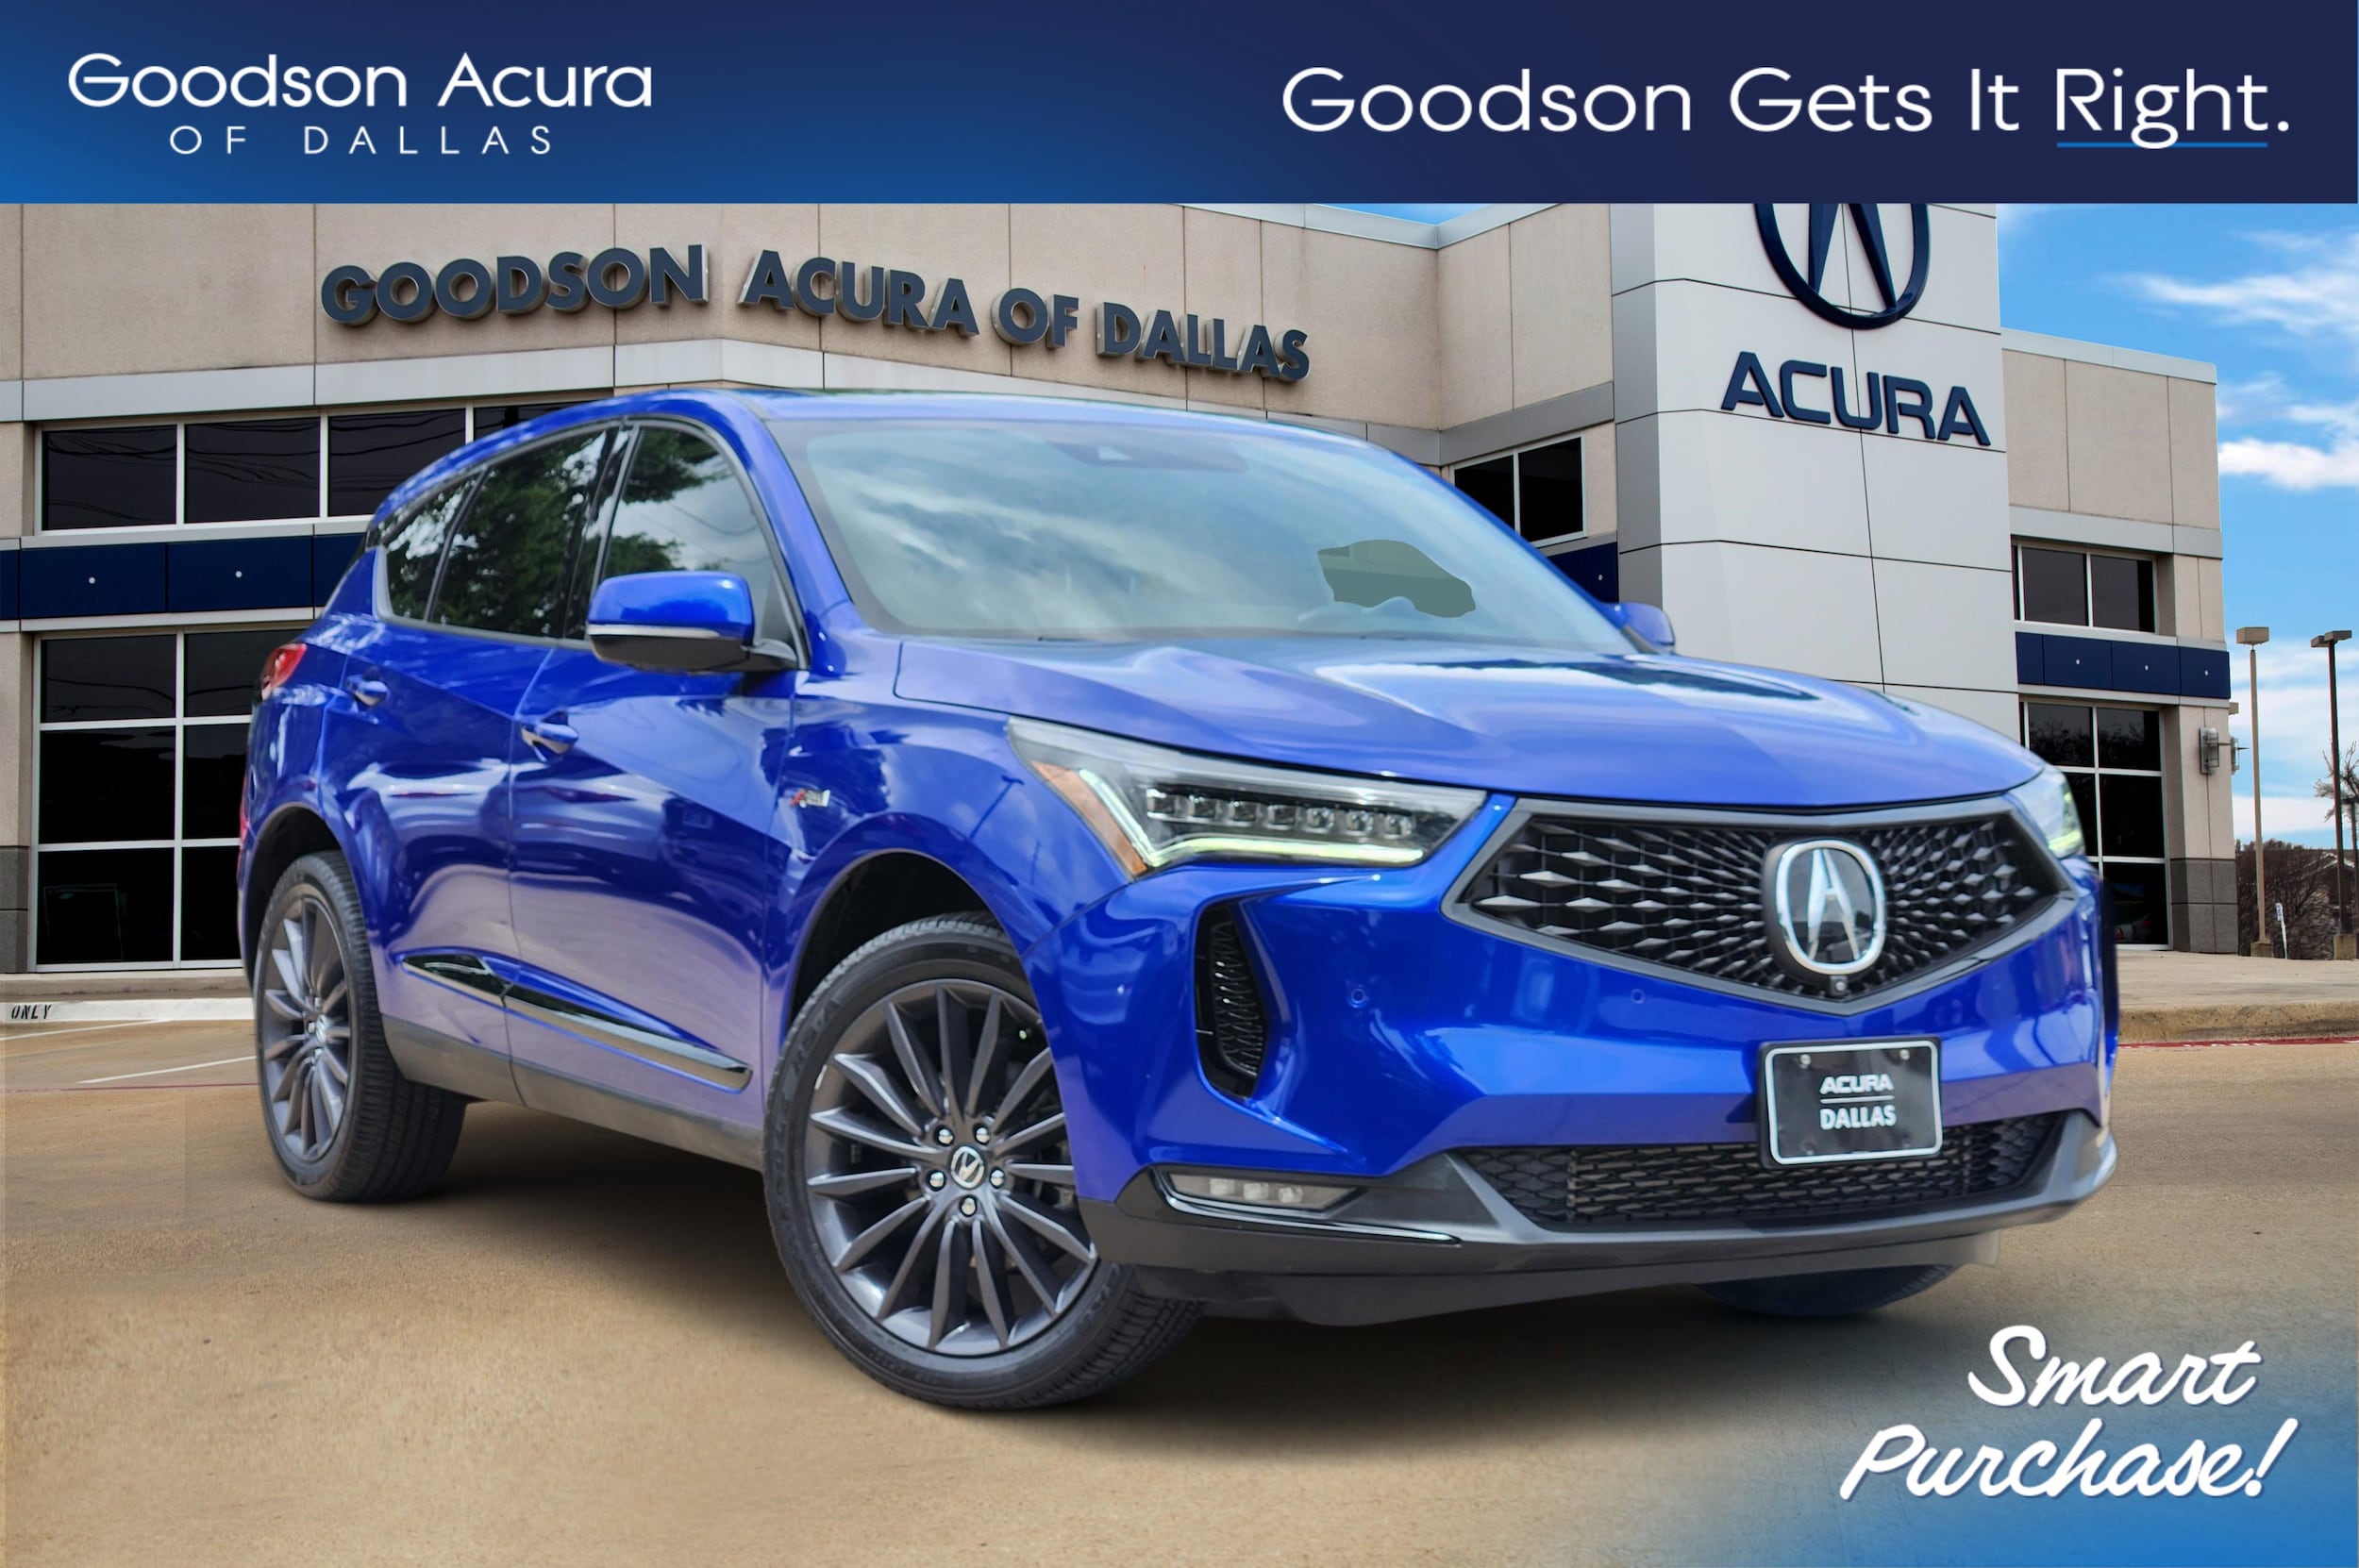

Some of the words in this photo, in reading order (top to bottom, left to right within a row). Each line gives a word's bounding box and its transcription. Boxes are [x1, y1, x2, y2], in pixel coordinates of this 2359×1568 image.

[321, 243, 709, 326] GOODSON
[739, 249, 979, 338] ACURA
[991, 287, 1079, 348] OF
[1096, 302, 1311, 382] DALLAS
[1720, 351, 1992, 446] ACURA
[11, 1004, 51, 1020] ONLY
[1819, 1074, 1895, 1094] ACURA
[1819, 1104, 1897, 1129] DALLAS
